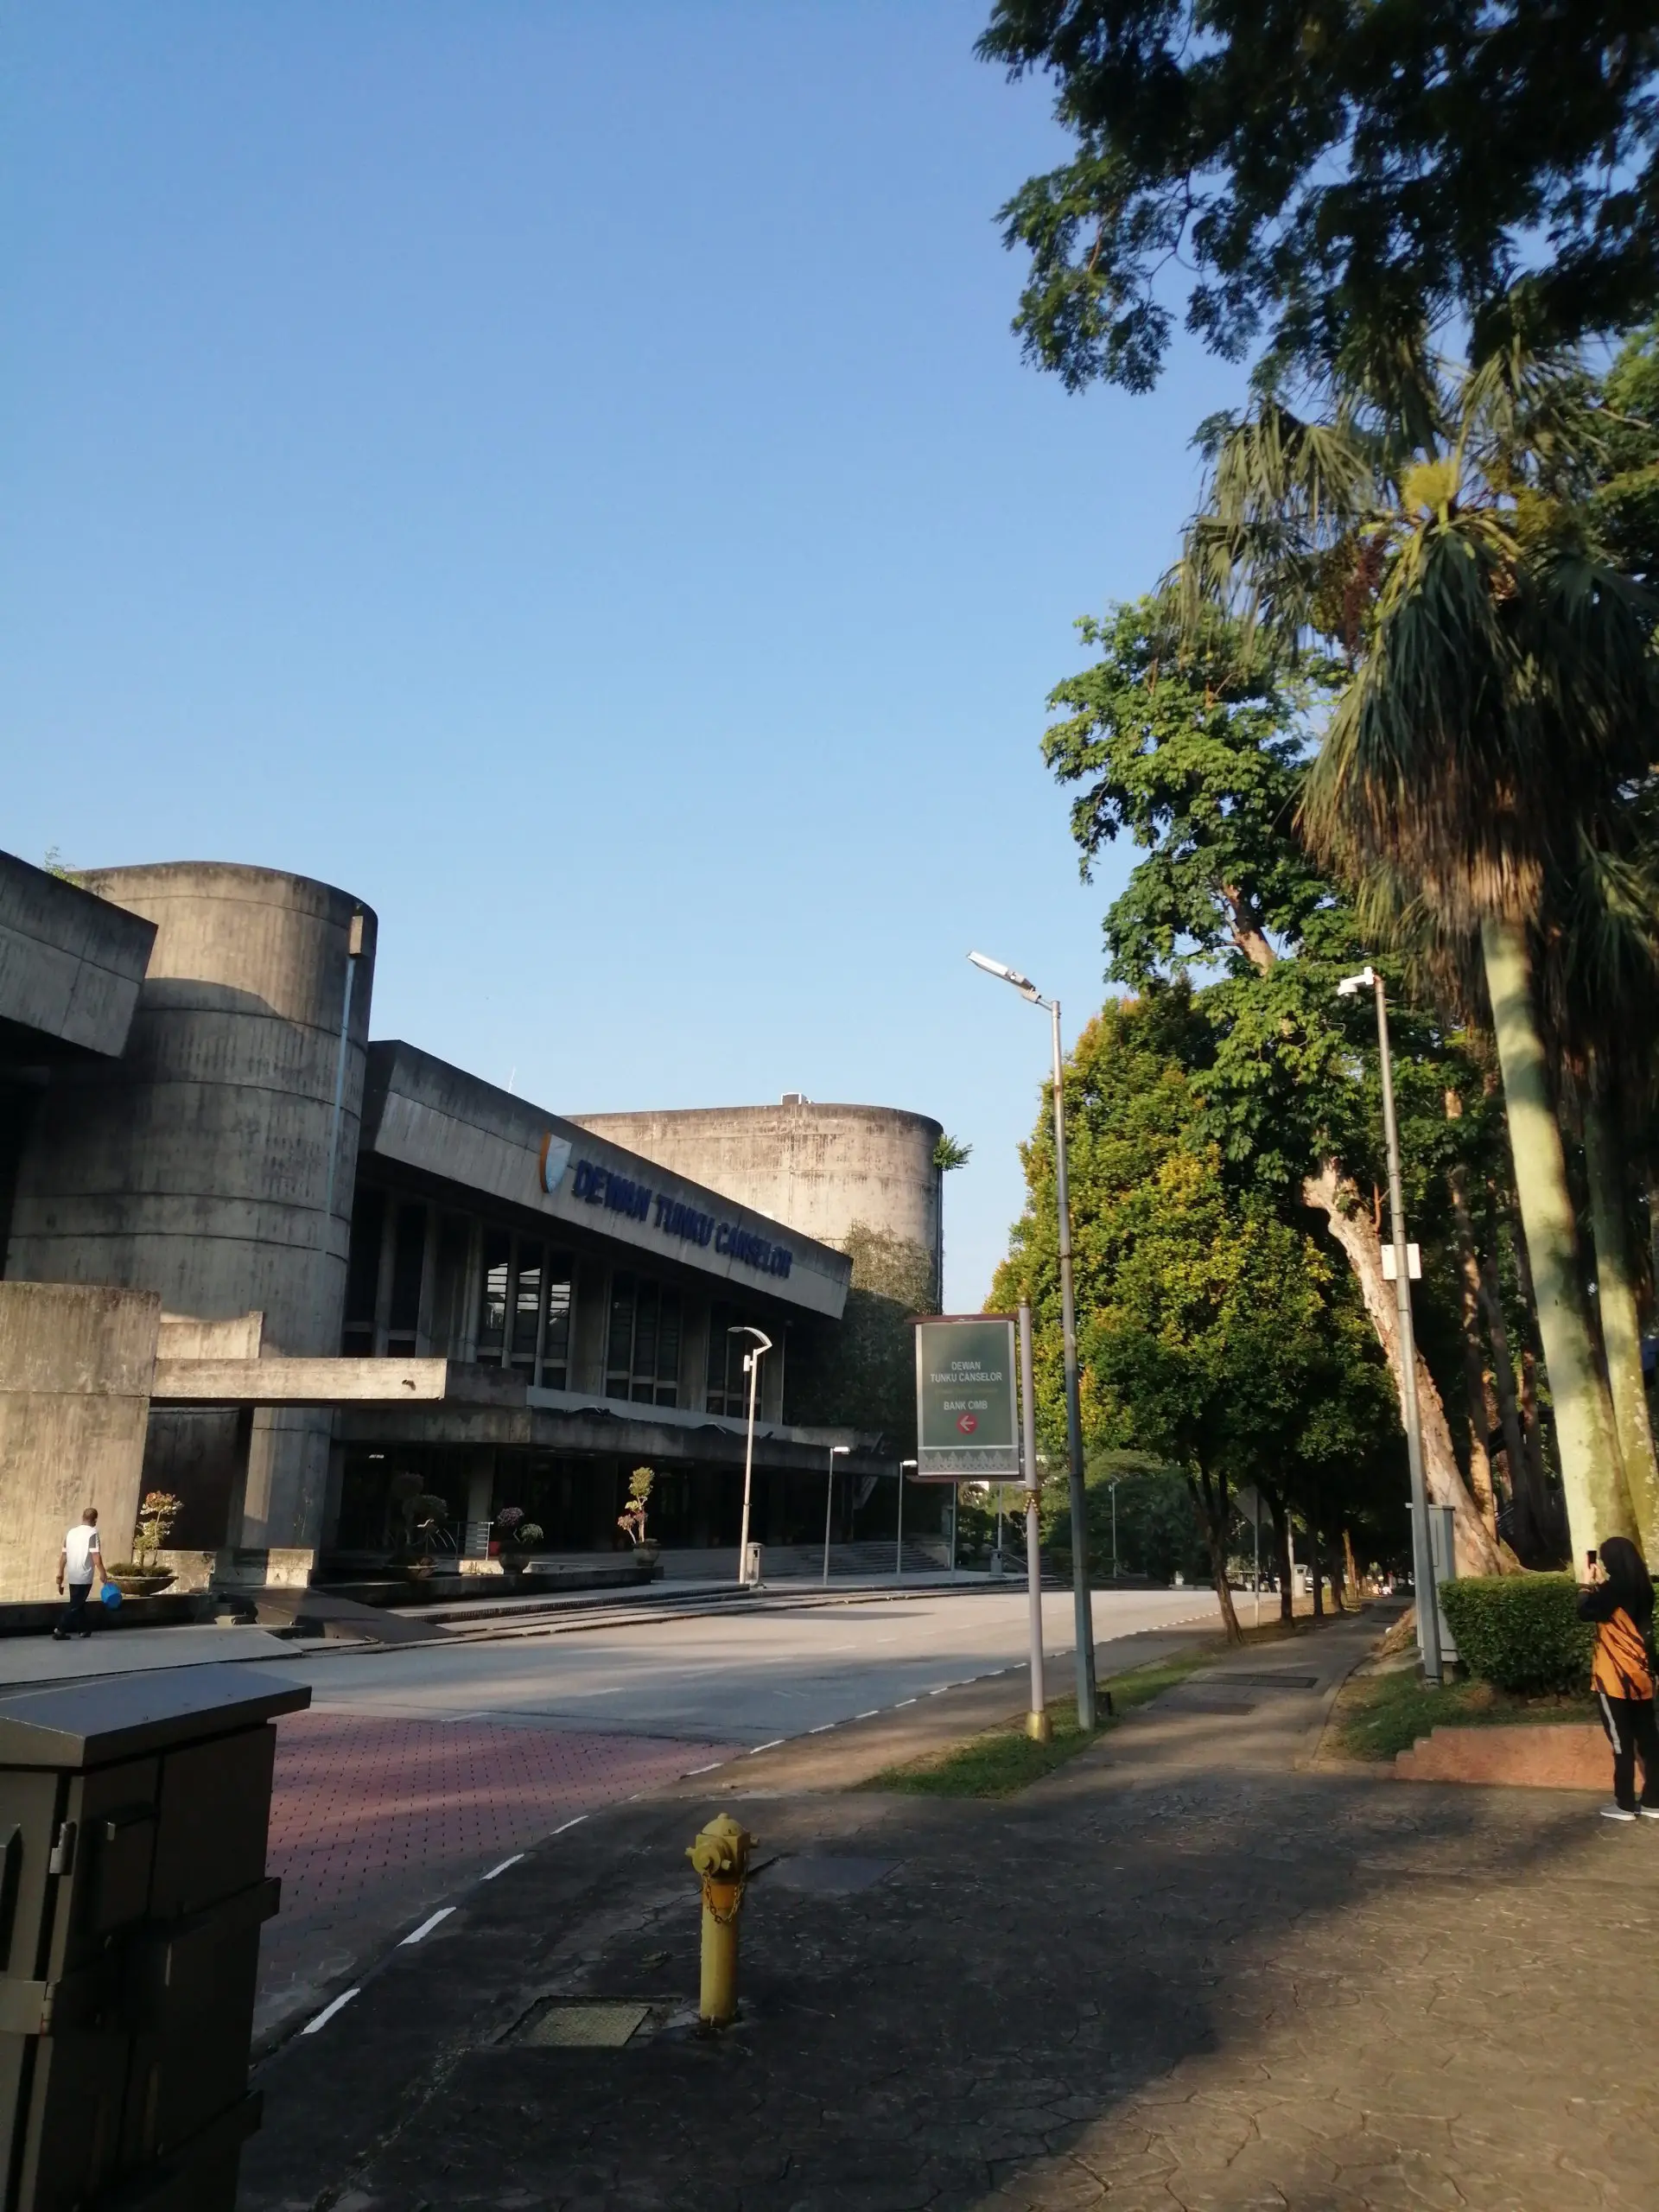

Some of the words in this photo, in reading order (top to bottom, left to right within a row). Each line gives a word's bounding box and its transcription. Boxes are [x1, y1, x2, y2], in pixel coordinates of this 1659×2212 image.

[571, 1160, 652, 1222] DEWAN
[654, 1193, 715, 1247] TUNKU
[715, 1222, 793, 1279] CANSELOR
[951, 1361, 982, 1370] DEWAN
[931, 1373, 957, 1382] TUNKU
[959, 1372, 1002, 1382] CANSELOR
[944, 1401, 966, 1410] BANK
[968, 1400, 988, 1409] CIMB
